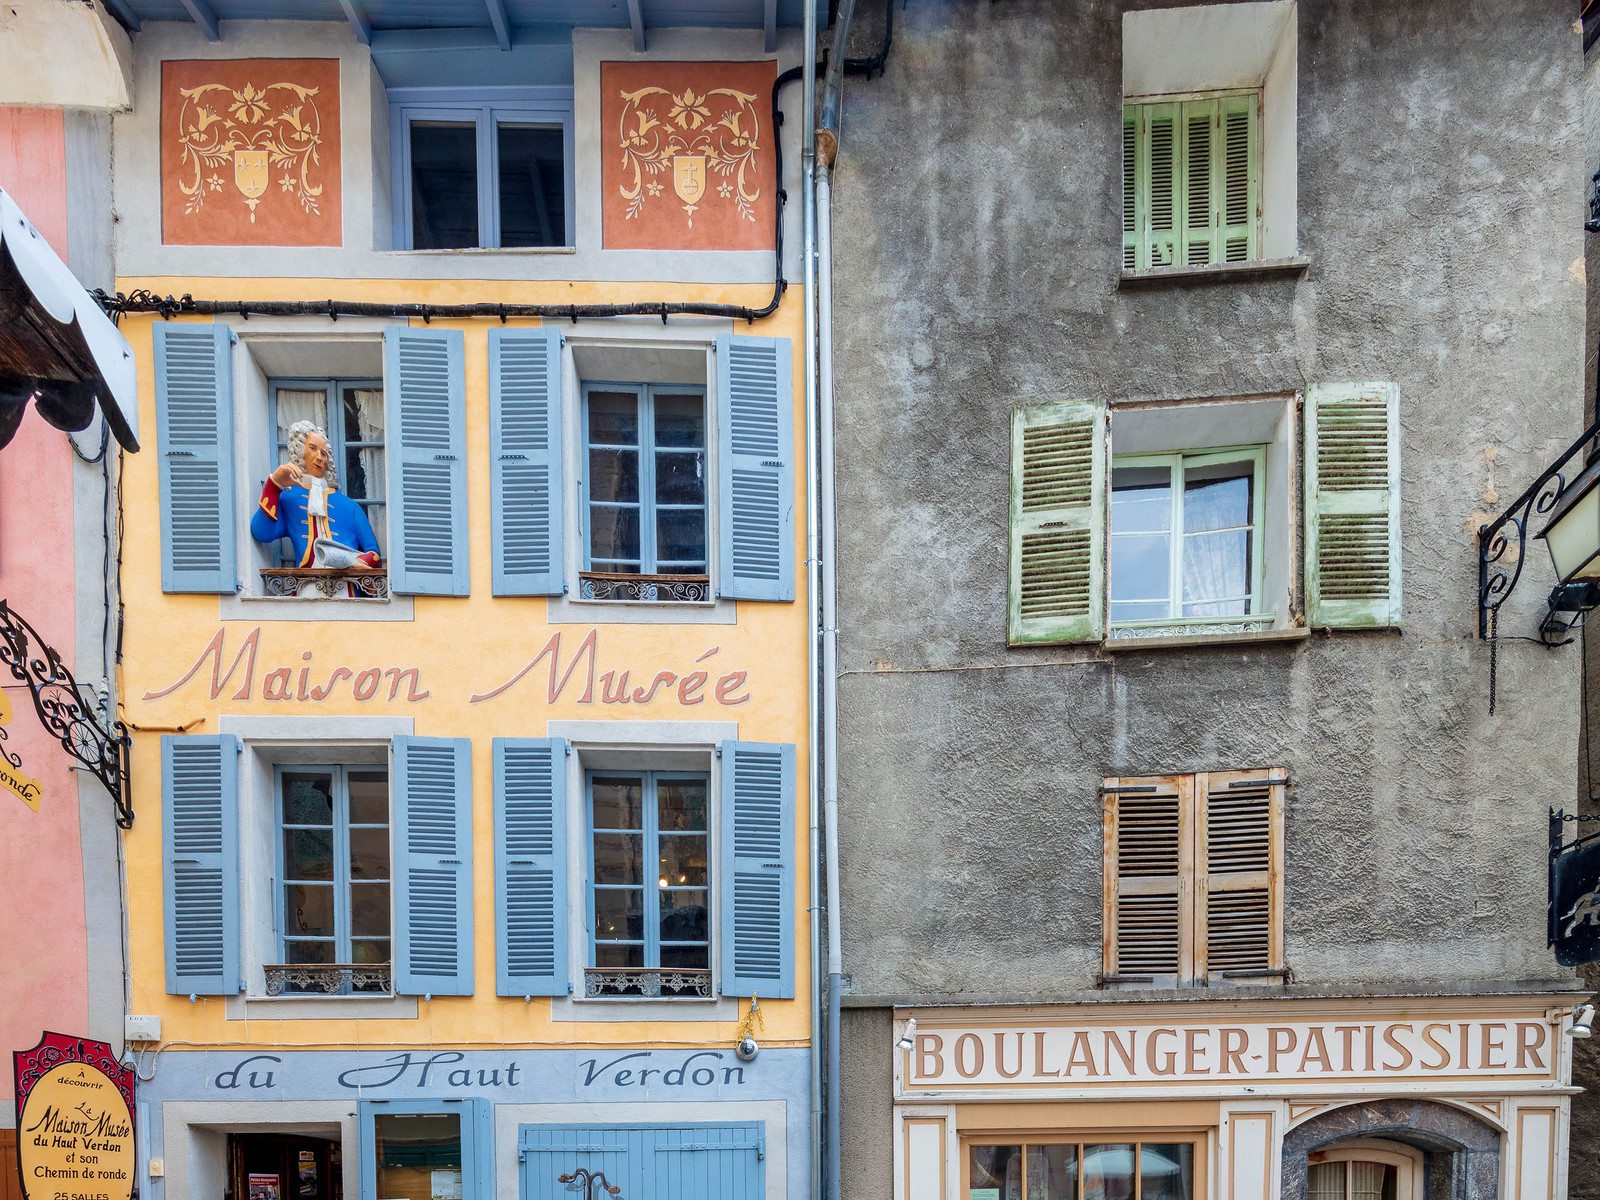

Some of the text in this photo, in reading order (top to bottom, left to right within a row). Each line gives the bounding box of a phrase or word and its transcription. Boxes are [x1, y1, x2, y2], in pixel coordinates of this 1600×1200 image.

[141, 626, 751, 706] Maison Musée
[0, 769, 40, 802] onde
[914, 1022, 1548, 1080] BOULANGER-PATISSIER
[77, 1067, 86, 1079] À
[214, 1051, 746, 1090] du Haut Verdon
[57, 1076, 103, 1090] découvrir
[26, 1104, 130, 1138] Maison Musée
[74, 1101, 100, 1122] La
[33, 1134, 121, 1153] du Haut Verdon
[65, 1152, 99, 1165] et son
[33, 1165, 127, 1180] Chemin de ronde
